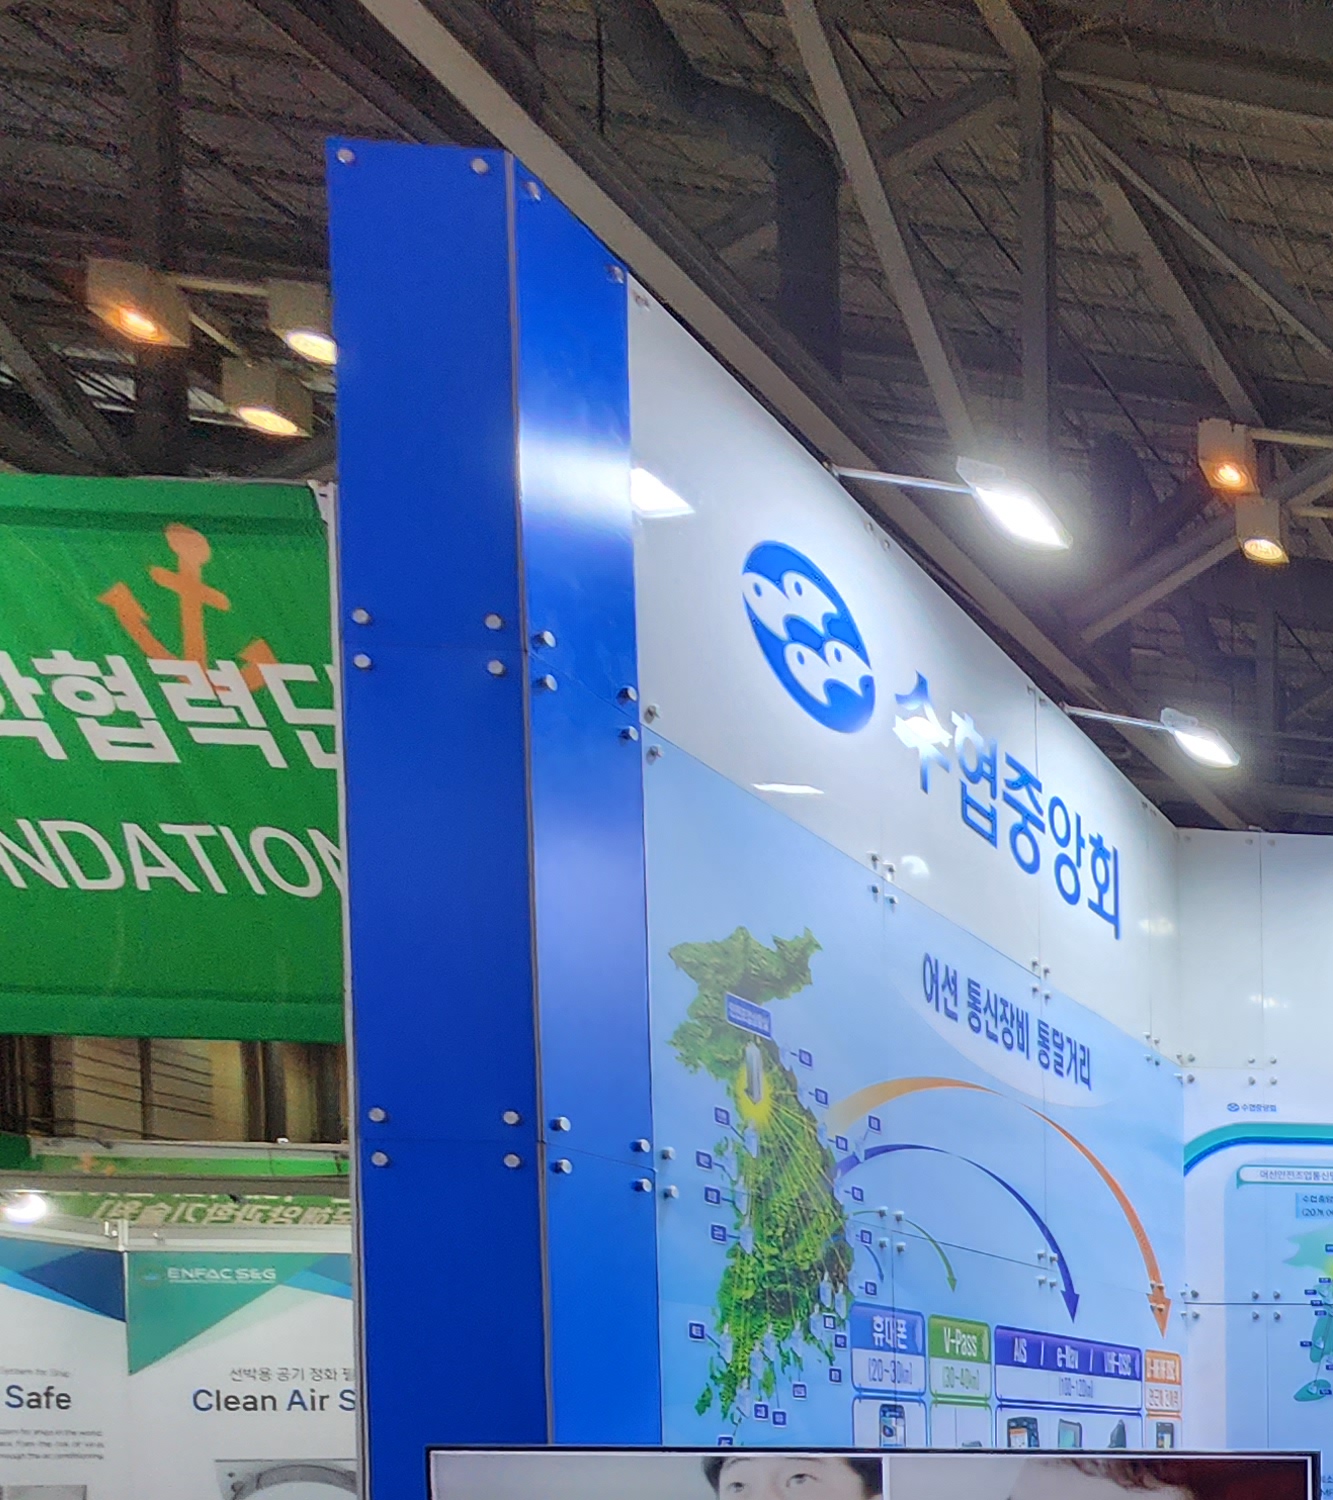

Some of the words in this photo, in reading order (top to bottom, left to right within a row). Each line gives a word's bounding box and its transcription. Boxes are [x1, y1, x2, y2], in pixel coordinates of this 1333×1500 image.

[892, 669, 1121, 940] 수협중앙회
[922, 952, 959, 1021] 어선
[965, 977, 1031, 1060] 통신장비
[1036, 1018, 1092, 1091] 통달거리
[167, 1268, 231, 1280] ENFAC
[872, 1315, 908, 1350] 휴대폰
[943, 1327, 978, 1357] V-Pass
[1013, 1336, 1028, 1364] AIS
[229, 1367, 272, 1382] 선박용
[276, 1367, 305, 1382] 공기
[310, 1367, 338, 1382] 정화
[5, 1384, 72, 1410] Safe
[192, 1388, 277, 1412] Clean
[286, 1388, 330, 1412] Air
